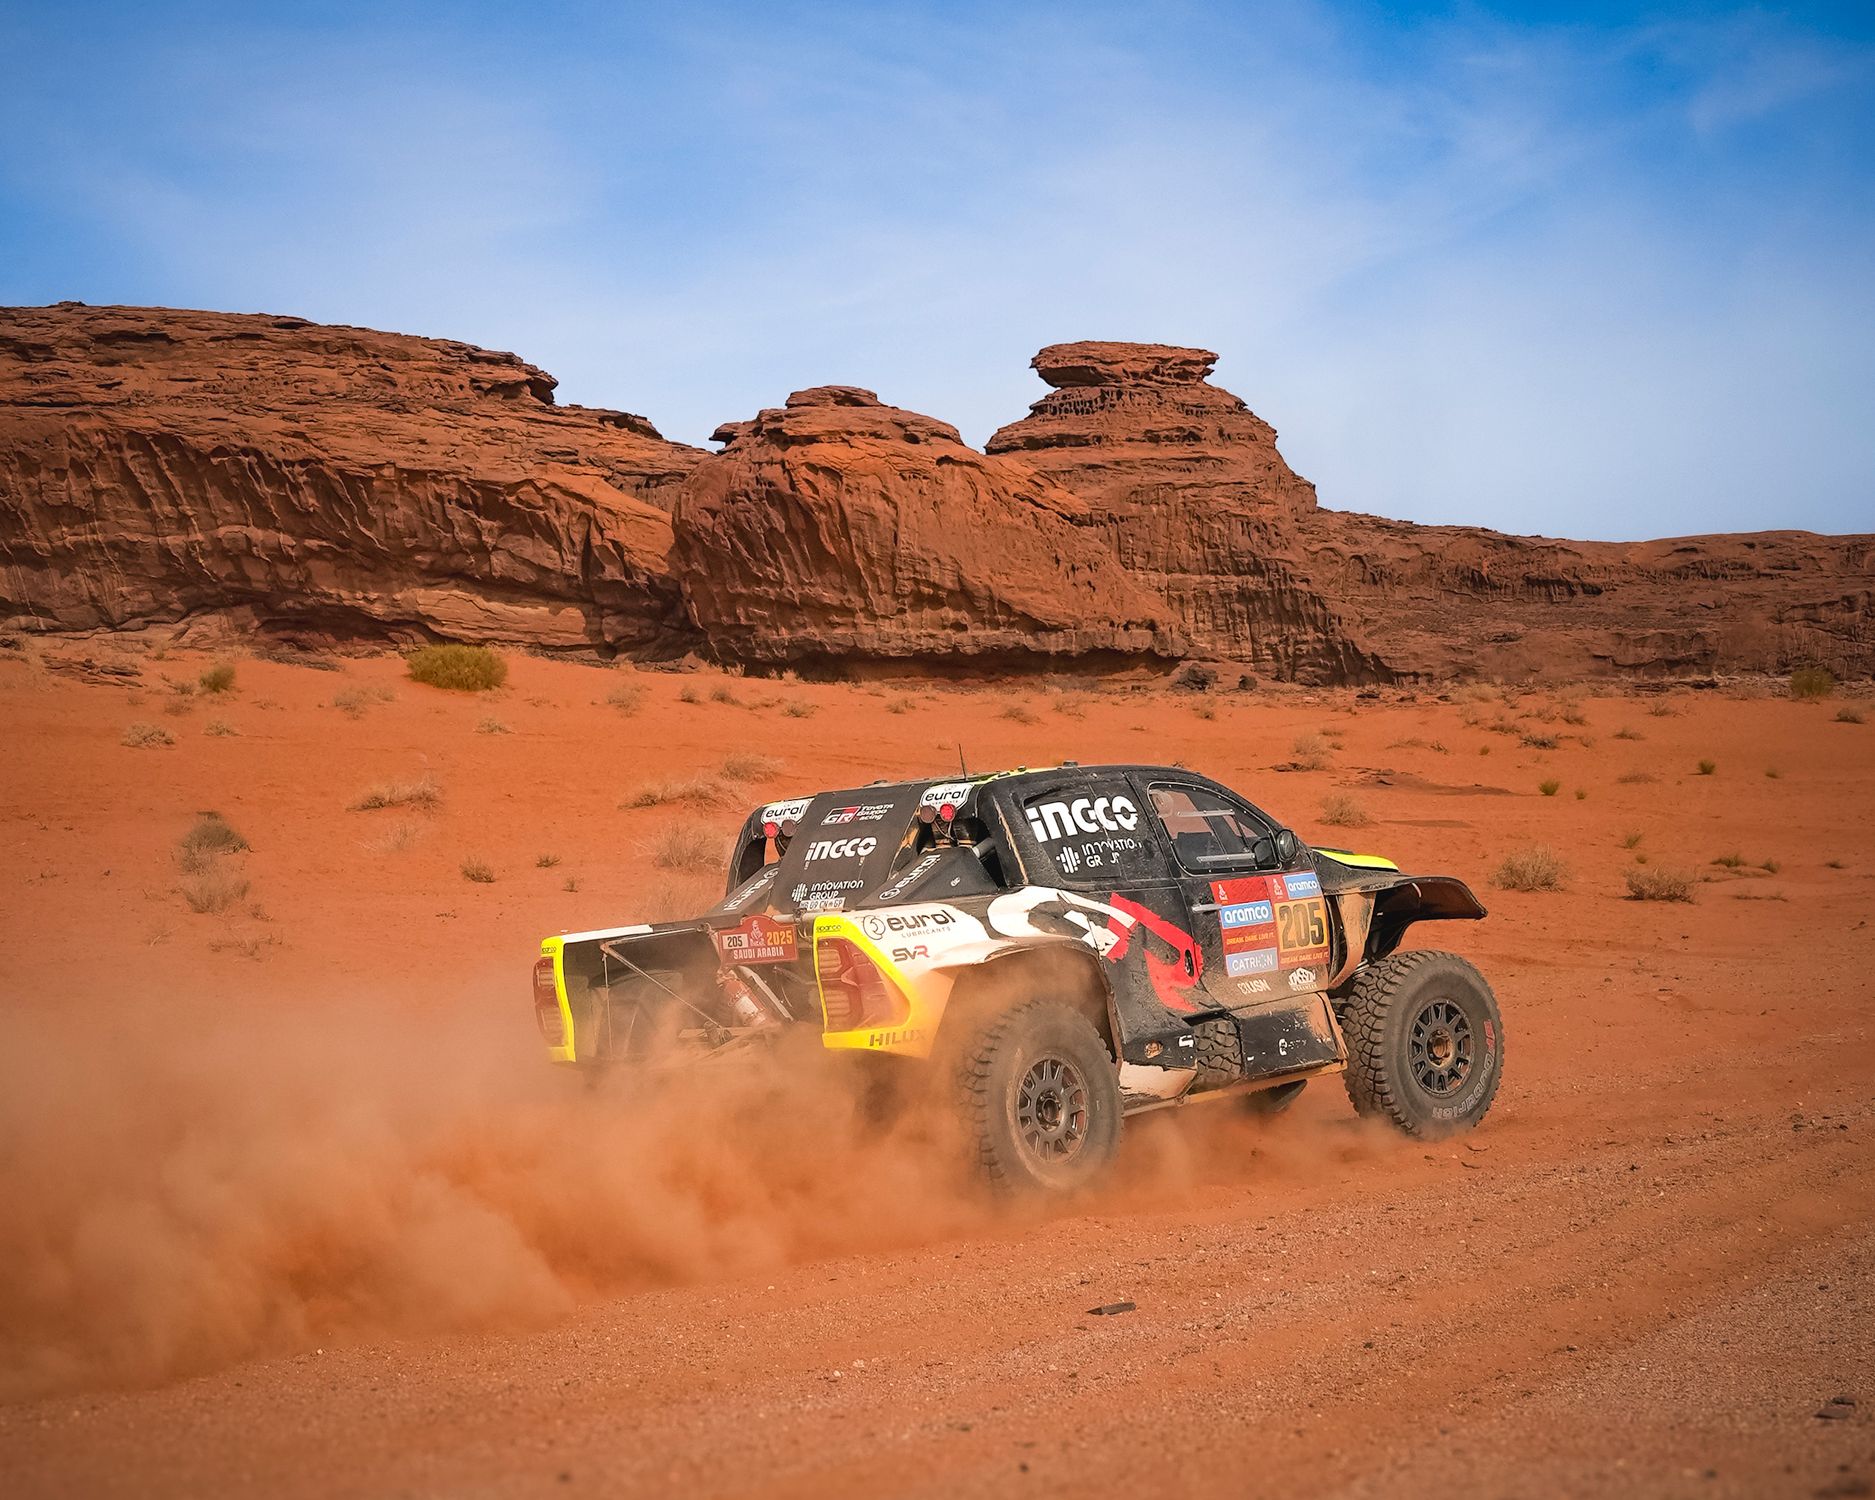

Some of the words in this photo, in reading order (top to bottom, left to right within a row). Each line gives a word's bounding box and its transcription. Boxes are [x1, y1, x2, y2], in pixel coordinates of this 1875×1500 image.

[925, 788, 966, 801] eurol
[765, 804, 804, 817] eurol
[824, 813, 853, 824] GR
[895, 854, 941, 888] eurol
[811, 880, 864, 891] INNOVATION
[1288, 880, 1317, 891] aramco
[809, 891, 839, 900] GROUP
[887, 910, 957, 931] eurol
[1224, 905, 1269, 923] aramco
[901, 926, 951, 938] LUBRICANTS
[1279, 902, 1325, 949] 205
[727, 936, 743, 948] 205
[766, 930, 793, 946] 2025
[733, 948, 755, 960] SAUDI
[757, 946, 784, 958] ARABIA
[892, 945, 930, 962] SVR
[1246, 979, 1271, 993] USN
